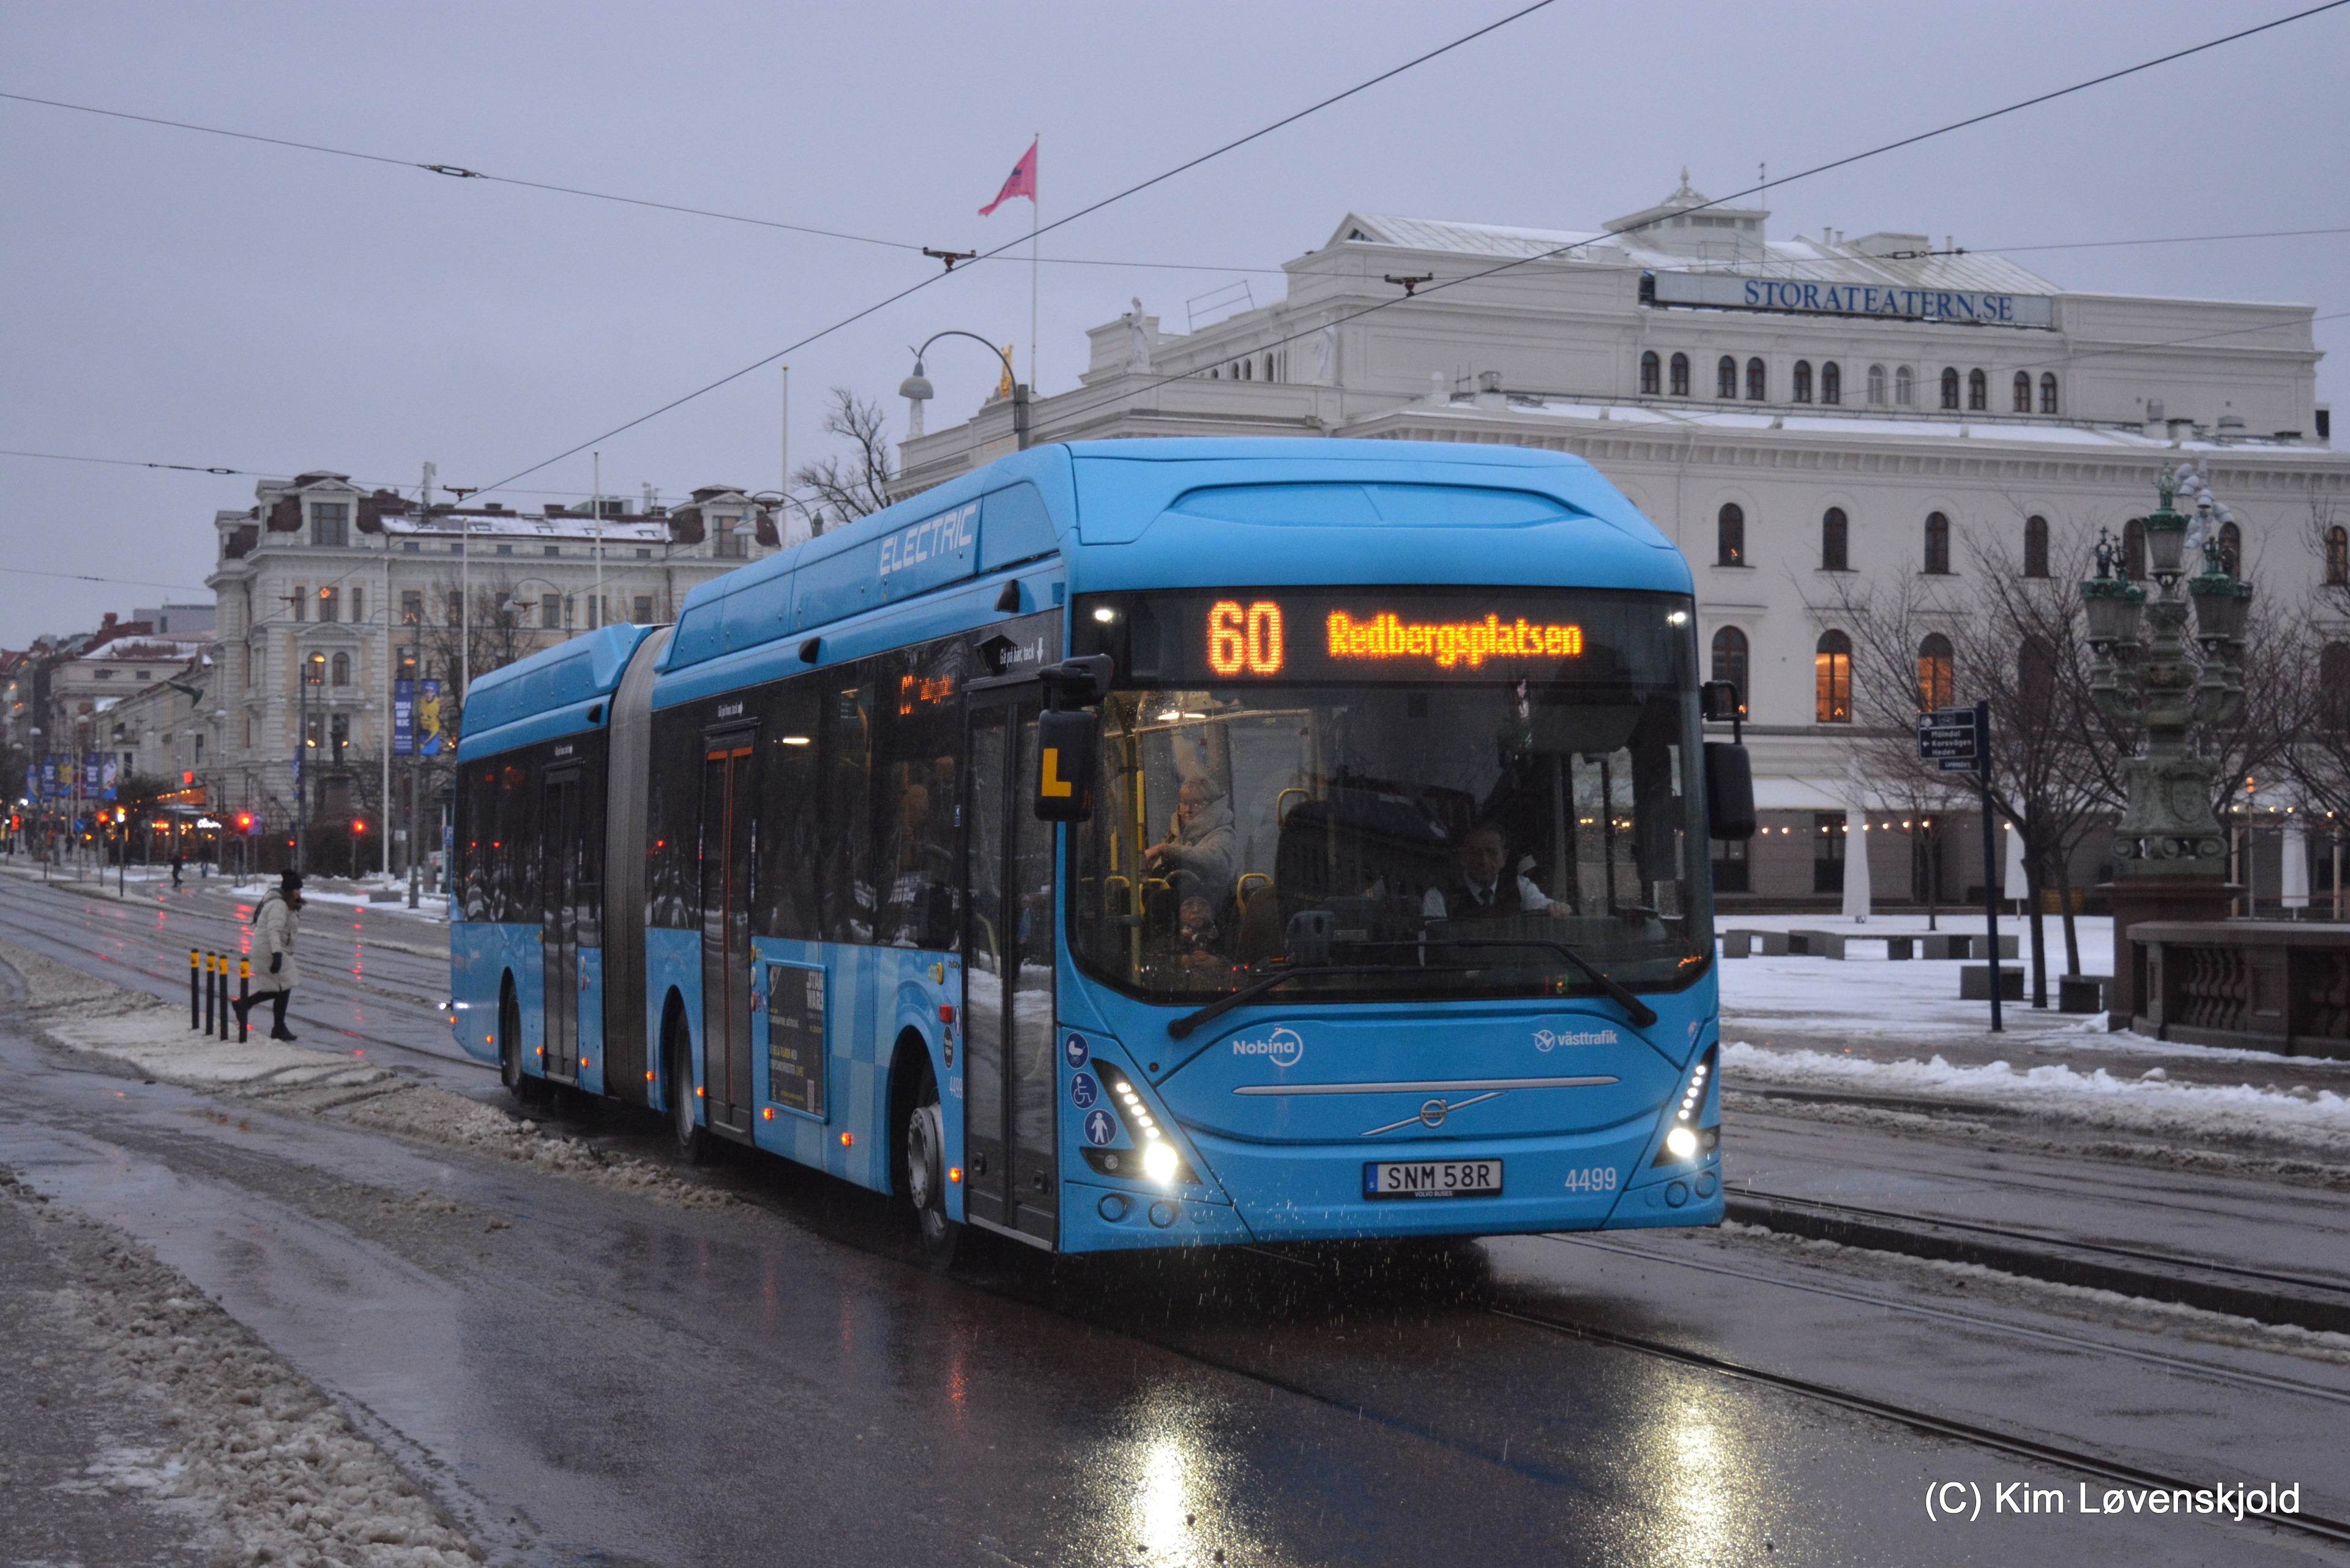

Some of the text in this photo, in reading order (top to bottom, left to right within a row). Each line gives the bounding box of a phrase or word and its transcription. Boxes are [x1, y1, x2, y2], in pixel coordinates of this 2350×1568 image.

[1744, 279, 2013, 321] STORATEATERN.SE
[879, 504, 977, 577] ELECTRIC
[1206, 600, 1583, 675] 60 Redbergsplatsen
[1000, 648, 1006, 665] Gå
[1007, 646, 1013, 668] på
[1024, 643, 1034, 660] tack
[1931, 739, 1972, 748] Korsvägen
[1233, 1039, 1294, 1055] Nobina
[1557, 1029, 1618, 1047] västtrafik
[949, 1075, 963, 1099] 4499
[1388, 1164, 1490, 1189] SNM 58R
[1565, 1167, 1617, 1192] 4499
